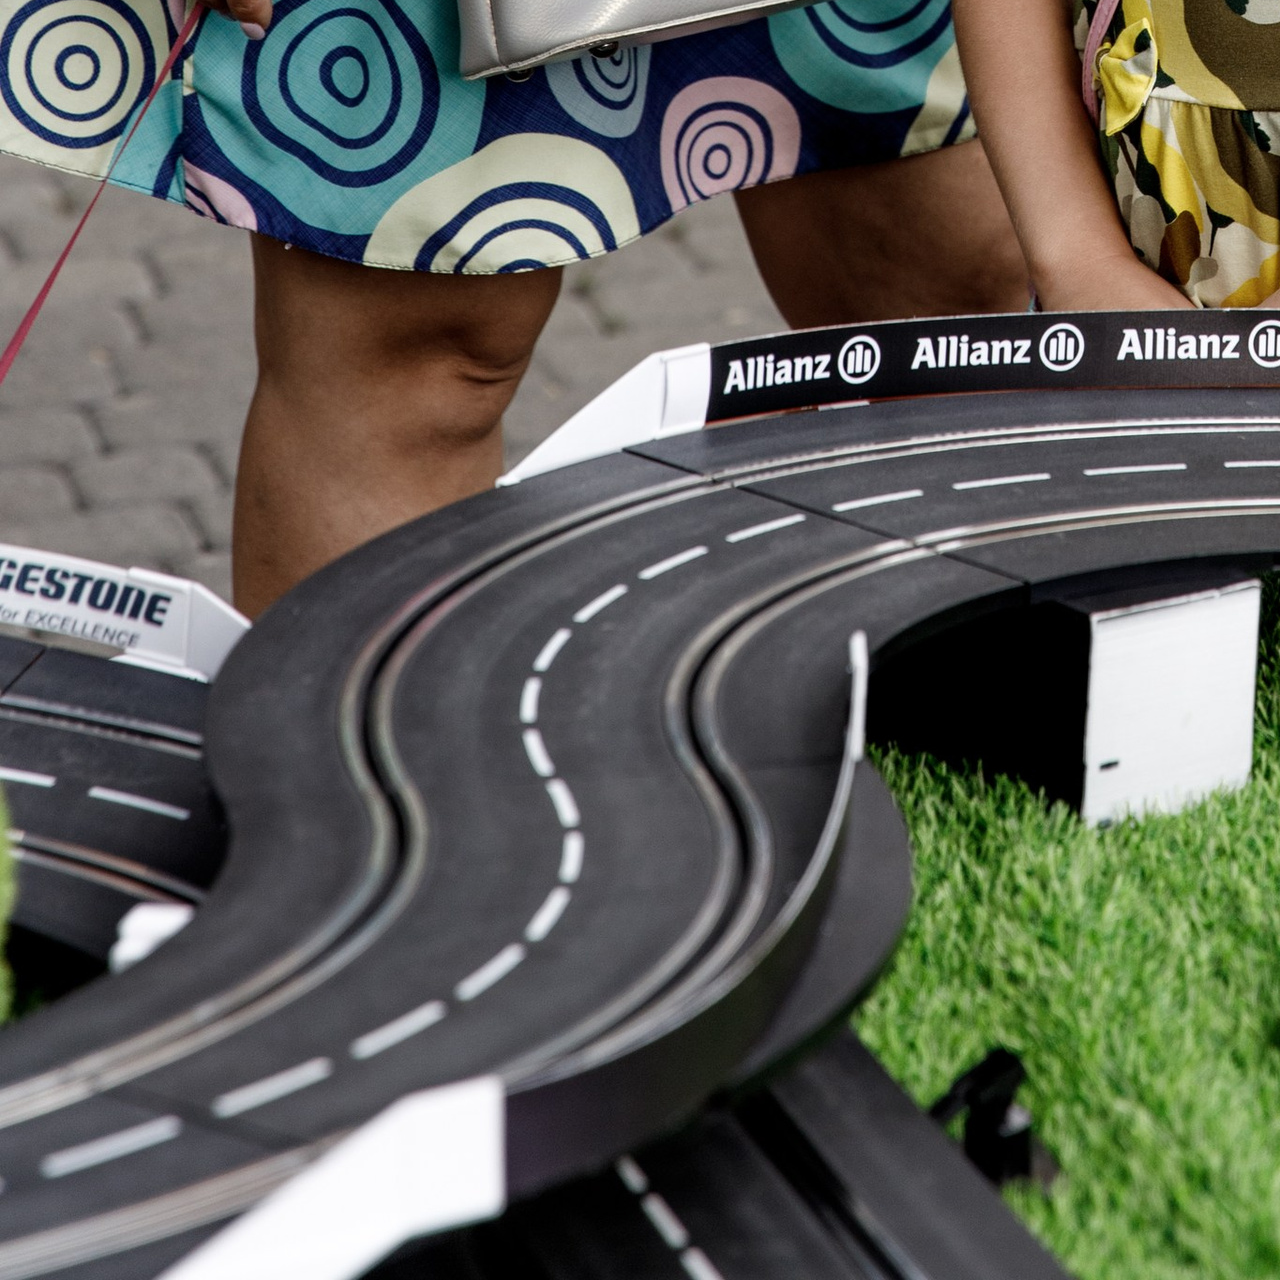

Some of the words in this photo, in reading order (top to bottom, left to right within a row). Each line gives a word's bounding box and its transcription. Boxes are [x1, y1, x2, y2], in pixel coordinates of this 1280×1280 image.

[723, 354, 831, 394] Allianz
[911, 335, 1032, 371] Allianz
[1116, 328, 1240, 361] Allianz
[24, 608, 141, 648] EXCELLENCE
